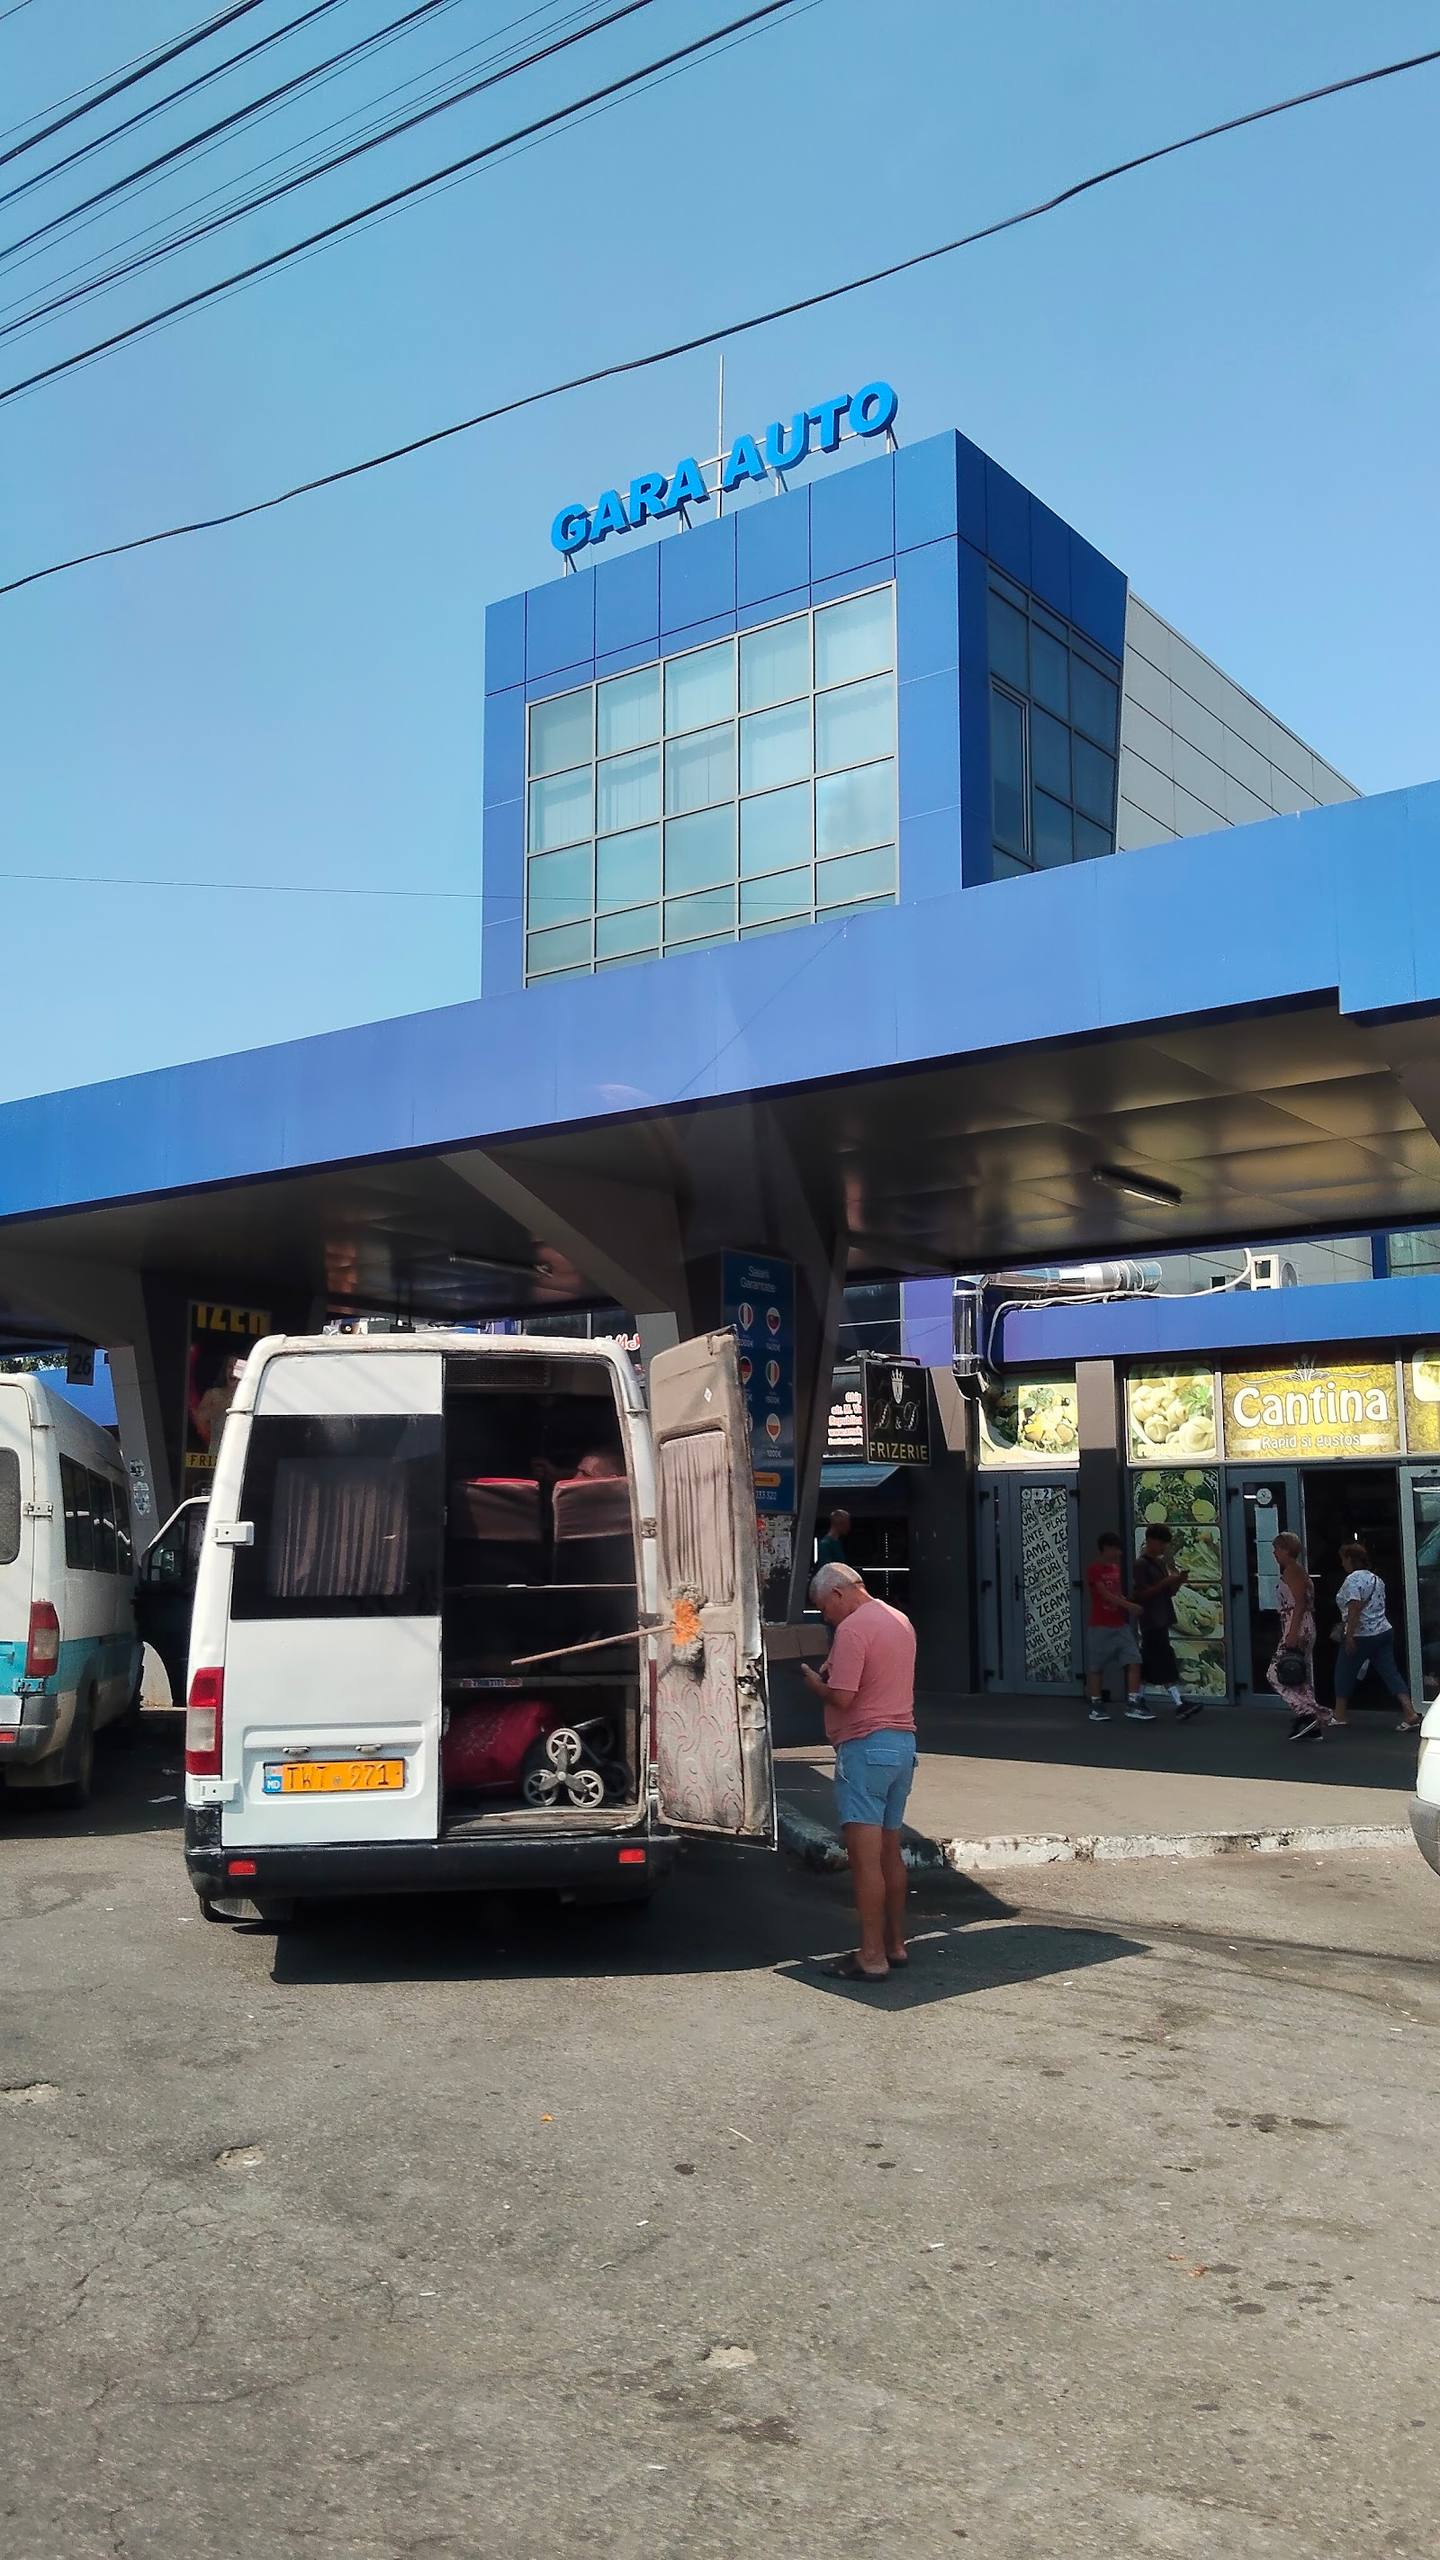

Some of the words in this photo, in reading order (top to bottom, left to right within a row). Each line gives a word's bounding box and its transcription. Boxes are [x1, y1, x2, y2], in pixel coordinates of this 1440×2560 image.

[551, 457, 711, 555] GARA
[722, 380, 899, 492] AUTO
[73, 1354, 92, 1376] 26
[1232, 1381, 1389, 1428] Cantina
[869, 1441, 928, 1460] FRIZERIE
[1261, 1434, 1297, 1450] Rapid
[349, 1764, 390, 1787] 971
